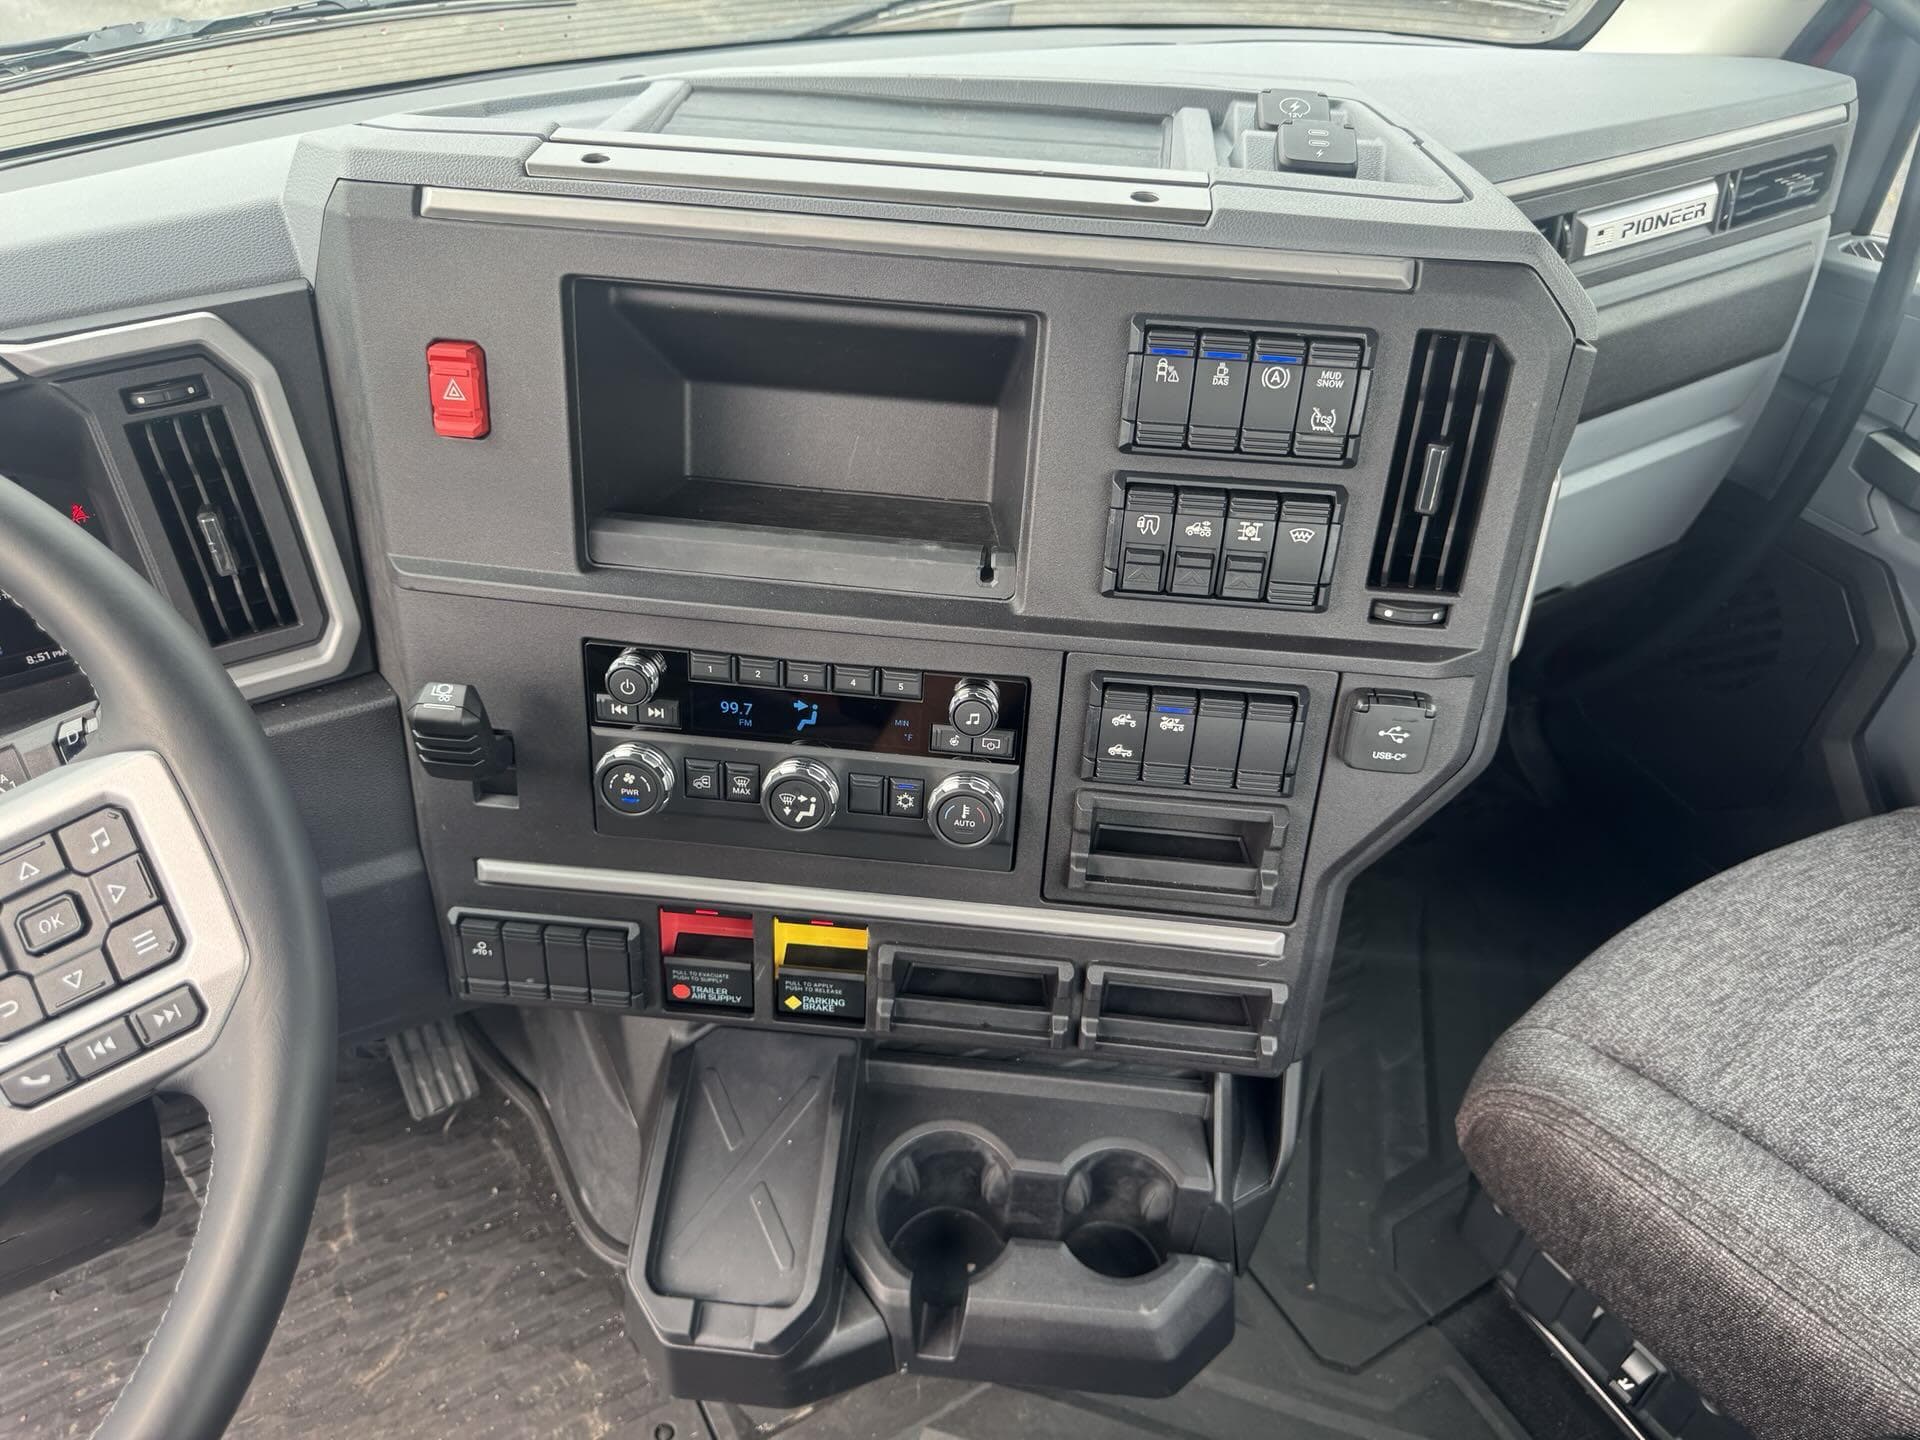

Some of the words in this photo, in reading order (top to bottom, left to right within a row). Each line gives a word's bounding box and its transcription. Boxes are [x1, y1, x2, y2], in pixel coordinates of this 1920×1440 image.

[1621, 202, 1707, 239] PIONEER
[1270, 370, 1281, 384] A
[1321, 370, 1342, 380] MUD
[1212, 377, 1229, 386] DAS
[1316, 378, 1345, 389] SNOW
[25, 651, 51, 665] 8:51
[707, 665, 713, 673] 1
[755, 670, 761, 678] 2
[802, 674, 809, 682] 3
[849, 679, 857, 687] 4
[898, 683, 904, 691] 5
[720, 701, 753, 716] 99.7
[738, 718, 753, 727] FM
[894, 719, 910, 727] MIN
[620, 788, 640, 796] PWR
[732, 787, 751, 796] MAX
[953, 819, 976, 828] AUTO
[39, 912, 65, 934] OK
[691, 985, 728, 995] TRAILER
[814, 987, 843, 995] RELEASE
[691, 992, 707, 1001] AIR
[708, 993, 742, 1003] SUPPLY
[802, 995, 846, 1007] PARKING
[802, 1002, 836, 1013] BRAKE
